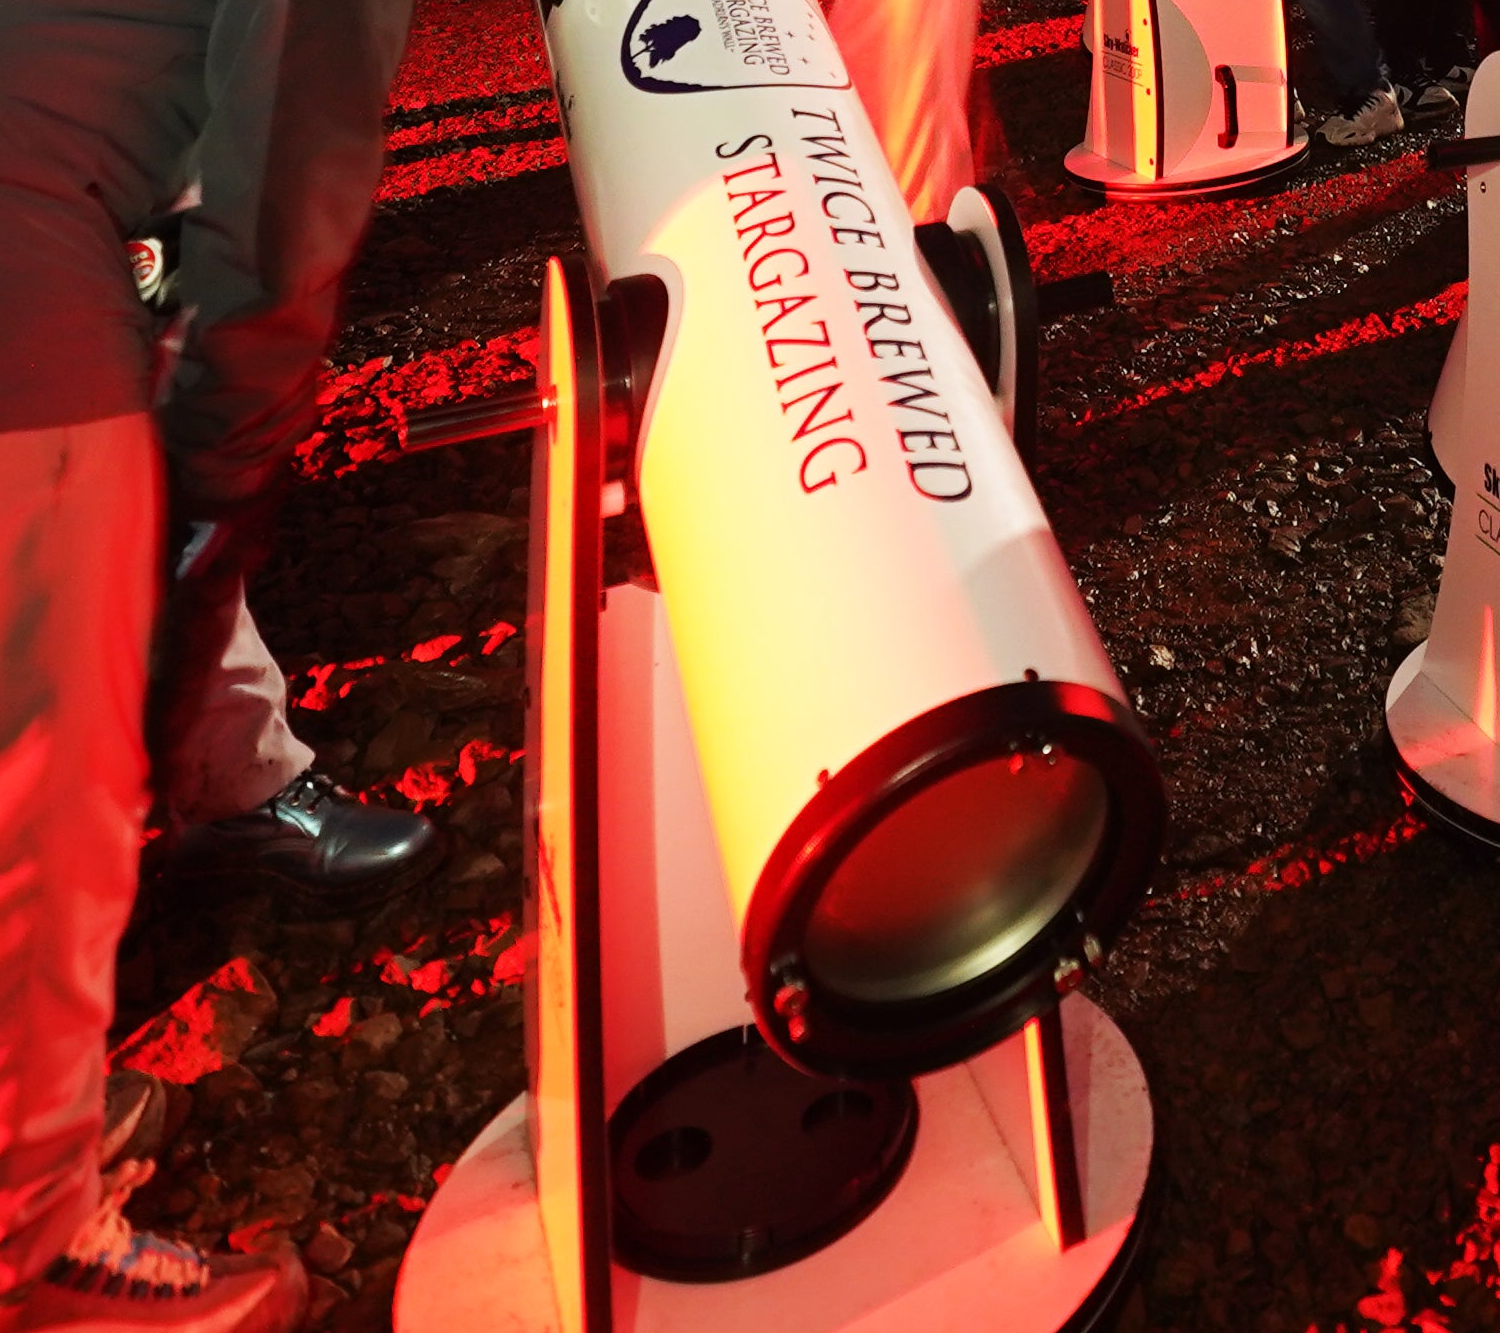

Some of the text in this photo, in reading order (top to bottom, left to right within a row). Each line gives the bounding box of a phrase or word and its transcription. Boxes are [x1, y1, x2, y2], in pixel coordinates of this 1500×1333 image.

[753, 16, 790, 76] BREWED
[715, 133, 869, 496] STARGAZING
[790, 108, 973, 503] TWICE BREWED
